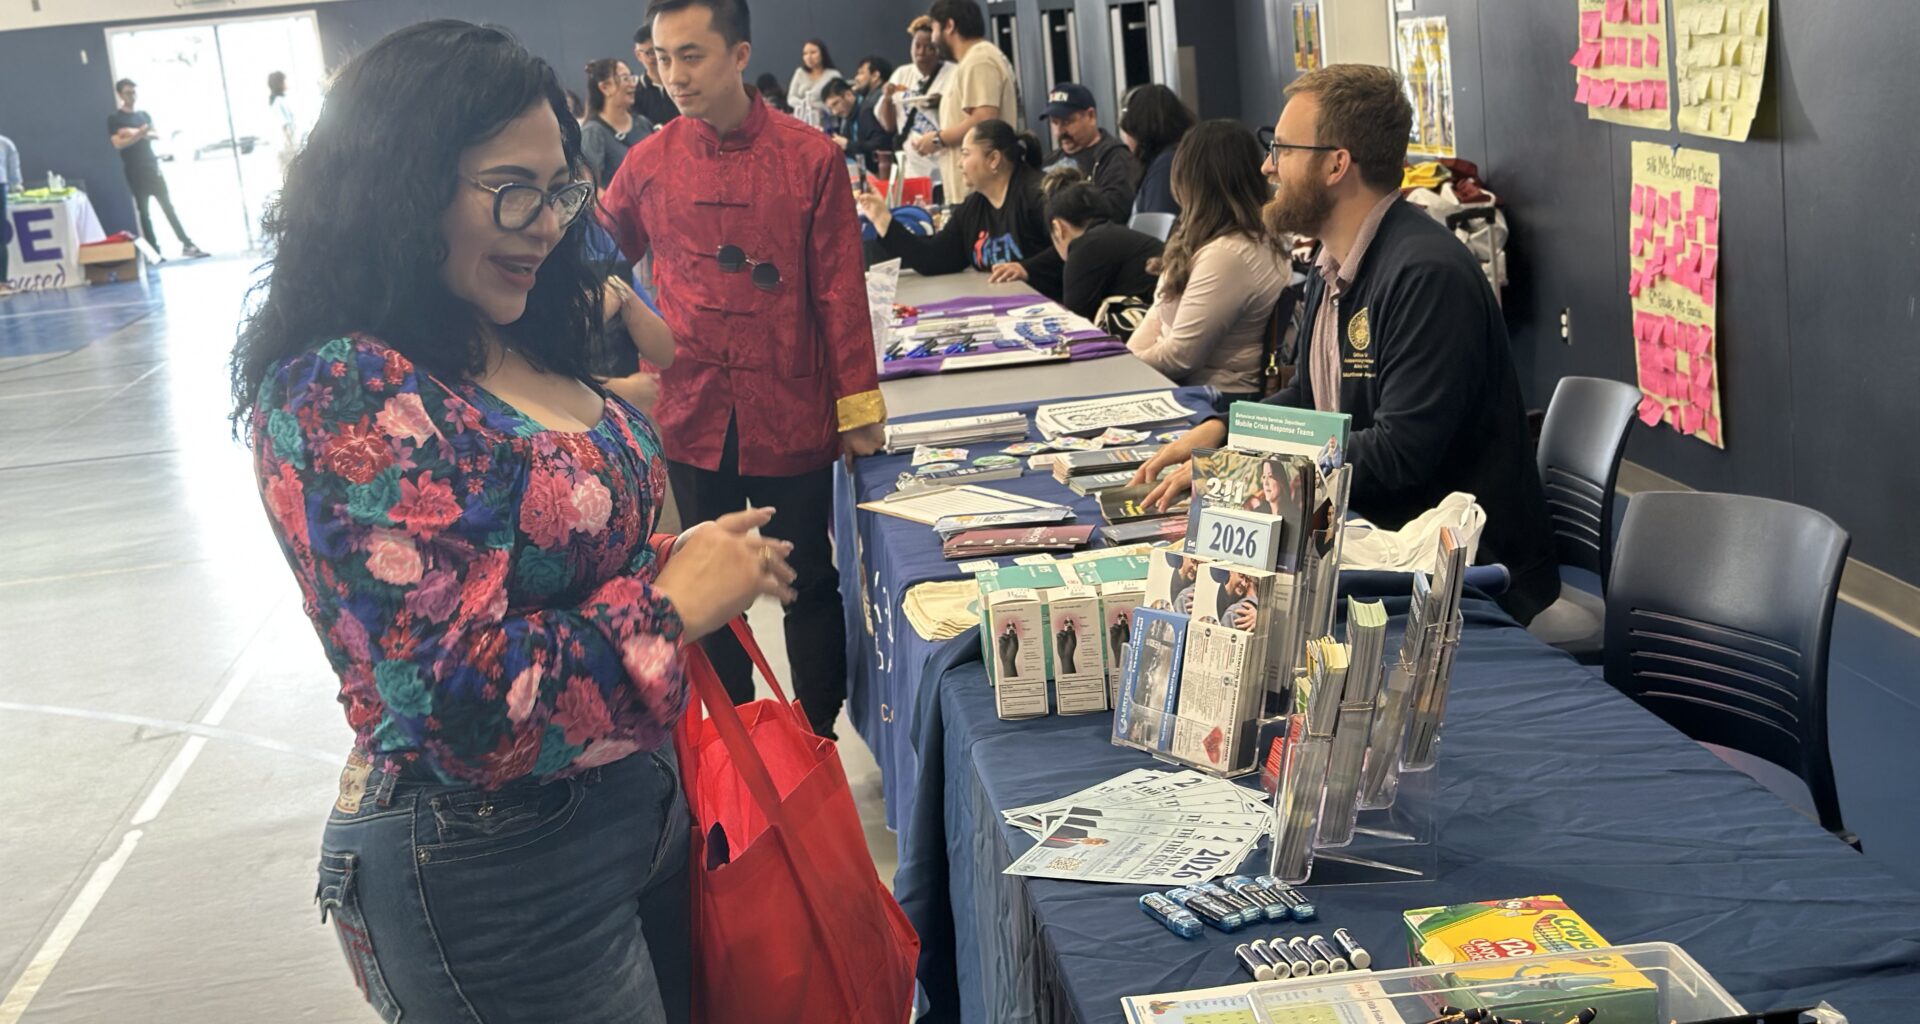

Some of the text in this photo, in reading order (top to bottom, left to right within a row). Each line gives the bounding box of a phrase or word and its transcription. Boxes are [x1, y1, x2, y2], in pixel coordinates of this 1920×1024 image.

[1235, 419, 1315, 437] Mobile Crisis Response Teams
[1209, 521, 1259, 559] 2026
[1160, 840, 1187, 855] THE
[1165, 846, 1194, 868] STATE
[1171, 848, 1231, 879] 2026
[1495, 938, 1533, 957] 120
